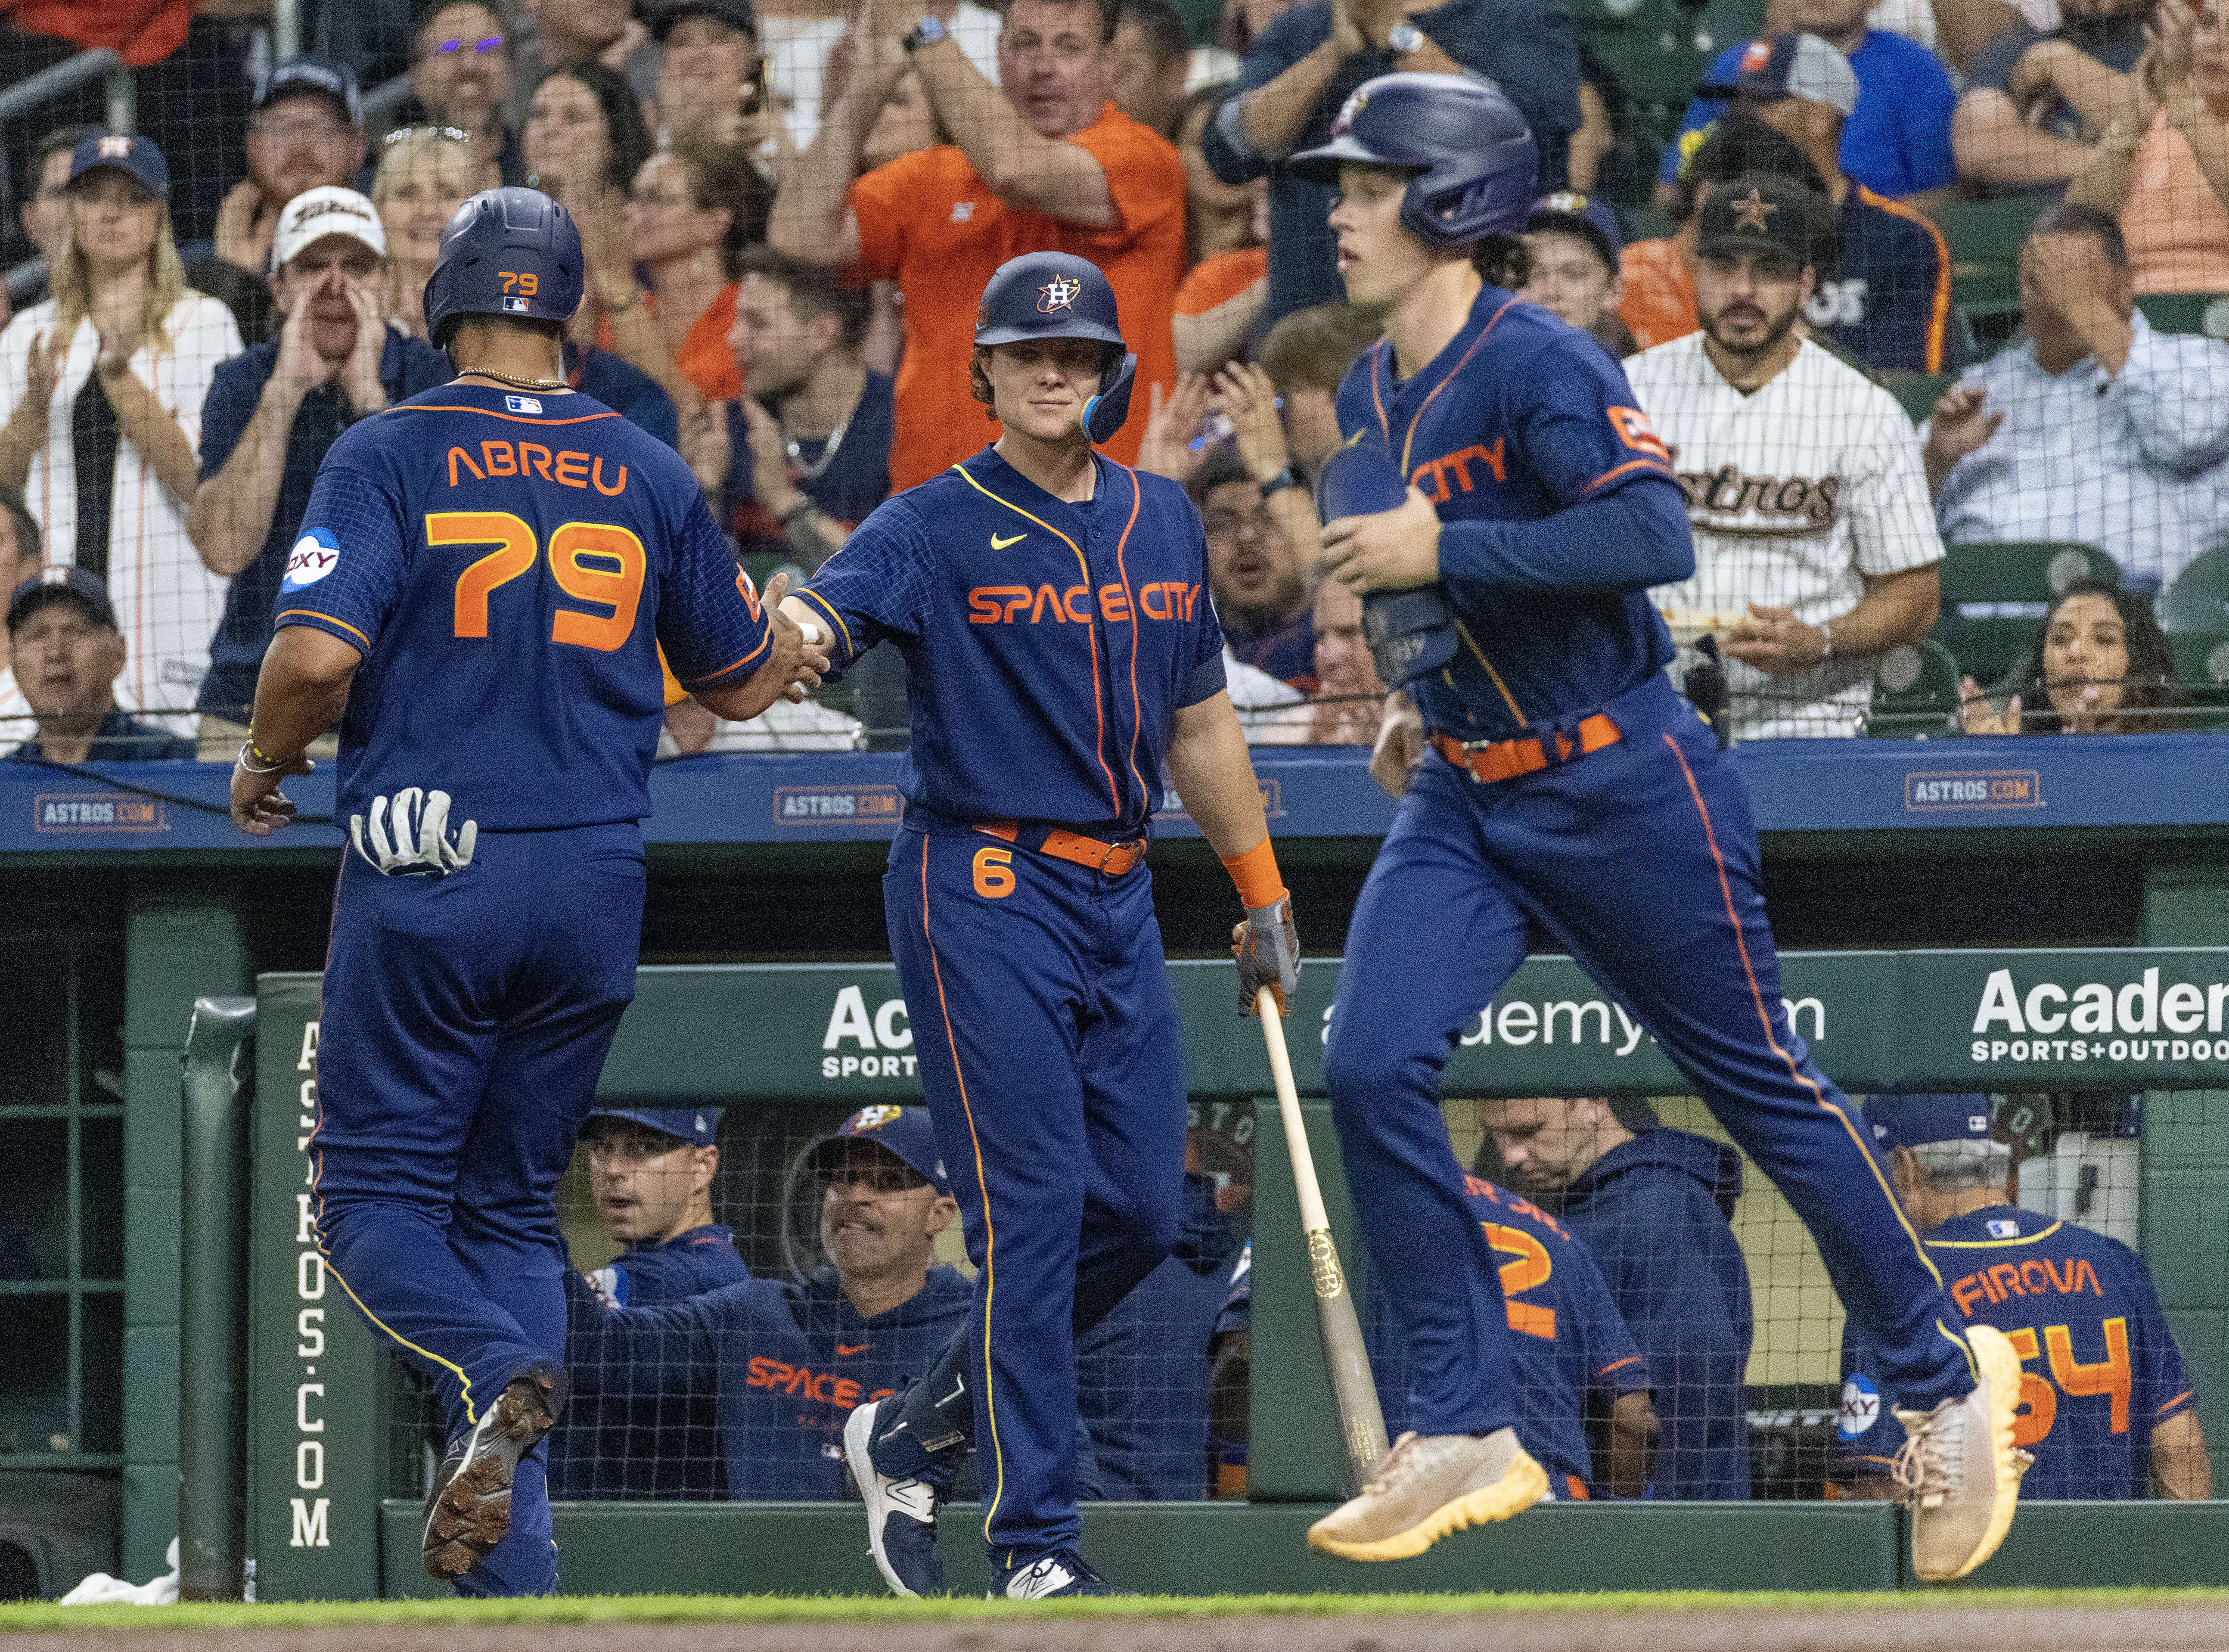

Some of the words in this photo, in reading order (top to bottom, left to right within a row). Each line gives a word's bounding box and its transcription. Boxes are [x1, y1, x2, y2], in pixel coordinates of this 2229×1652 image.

[498, 271, 538, 295] 79
[1048, 283, 1070, 305] H
[448, 441, 627, 496] ABREU
[1678, 463, 1840, 526] stros
[286, 552, 337, 574] OXY
[425, 512, 646, 651] 79
[969, 583, 1130, 624] SPACE
[1139, 582, 1201, 622] CITY
[1915, 779, 2030, 801] ASTROS.COM
[972, 847, 1016, 898] 6
[1952, 1259, 2102, 1317] FIROVA
[747, 1356, 861, 1409] SPACE
